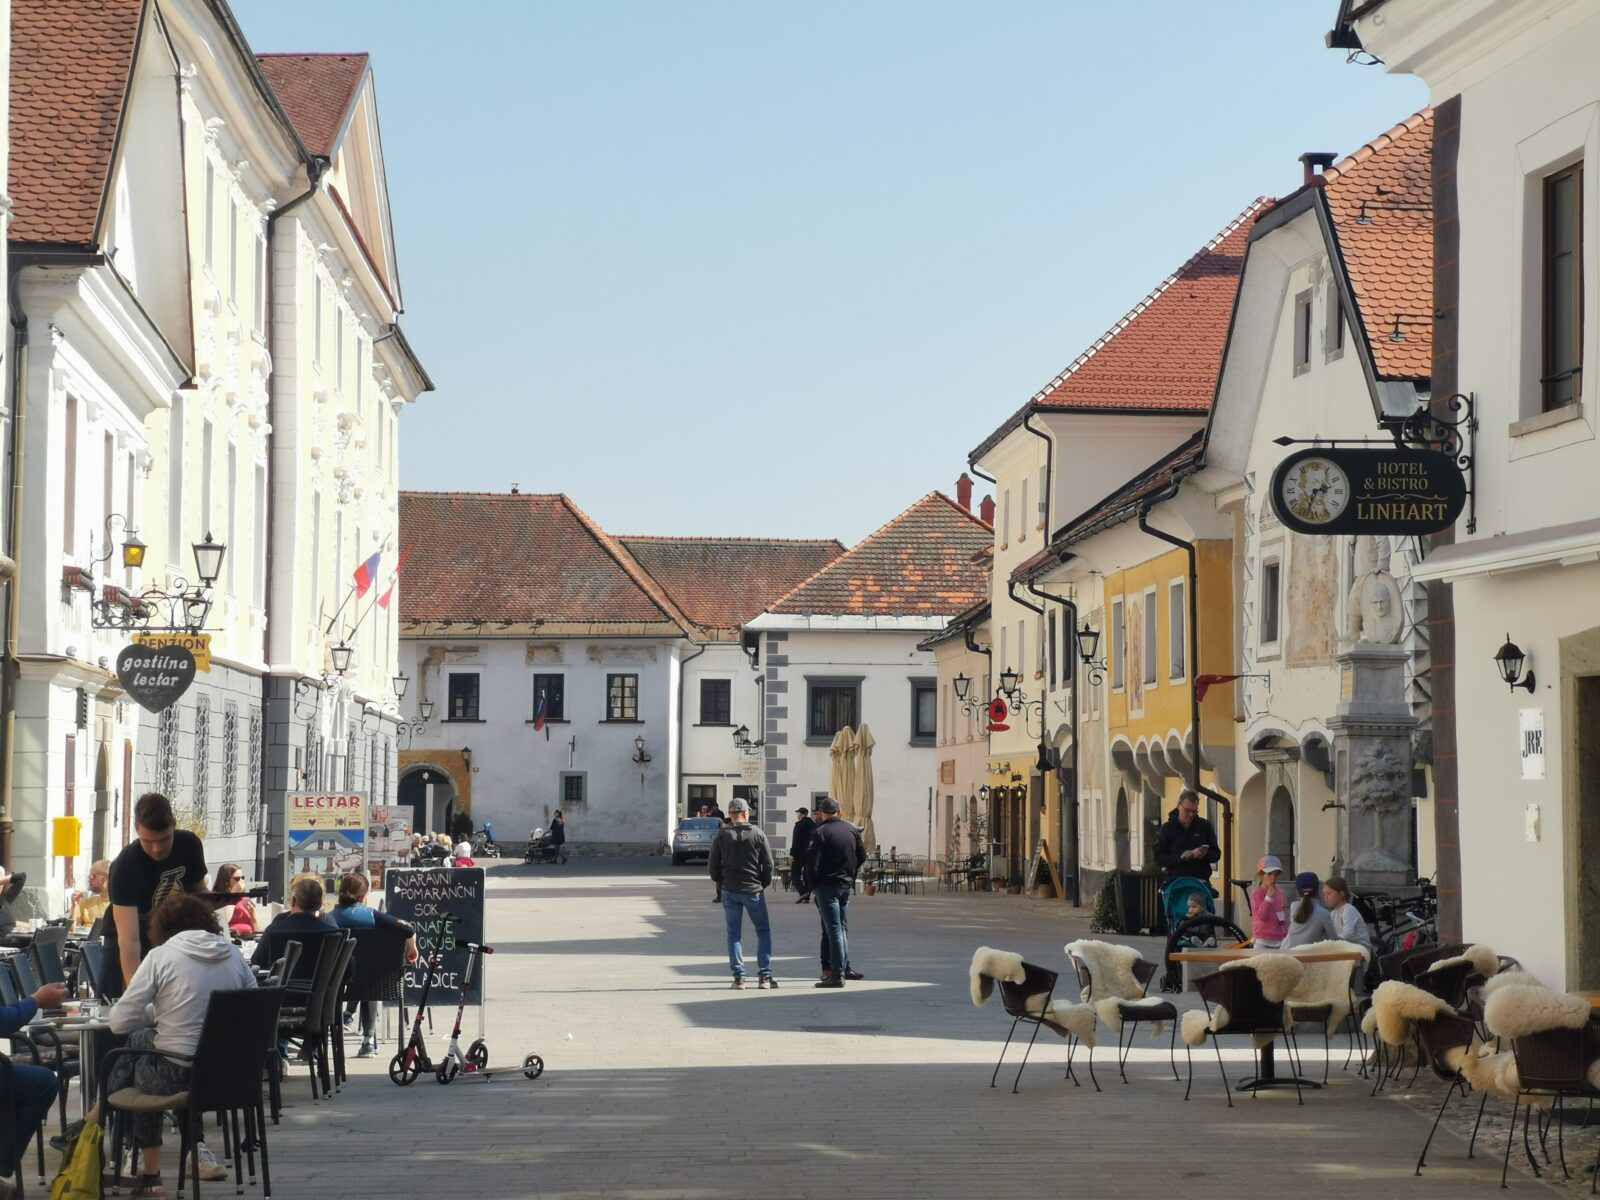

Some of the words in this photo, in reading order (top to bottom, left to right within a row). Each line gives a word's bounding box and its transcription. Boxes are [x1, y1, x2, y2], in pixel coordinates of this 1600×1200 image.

[1377, 462, 1427, 474] HOTEL
[1363, 479, 1375, 490] &
[1377, 478, 1428, 490] BISTRO
[1357, 503, 1447, 520] LINHART
[122, 655, 188, 671] gostilna
[133, 672, 179, 686] lectar
[294, 796, 361, 808] LECTAR
[397, 873, 452, 887] NARAVNI
[414, 903, 439, 917] SOK
[404, 971, 458, 989] SLADICE
